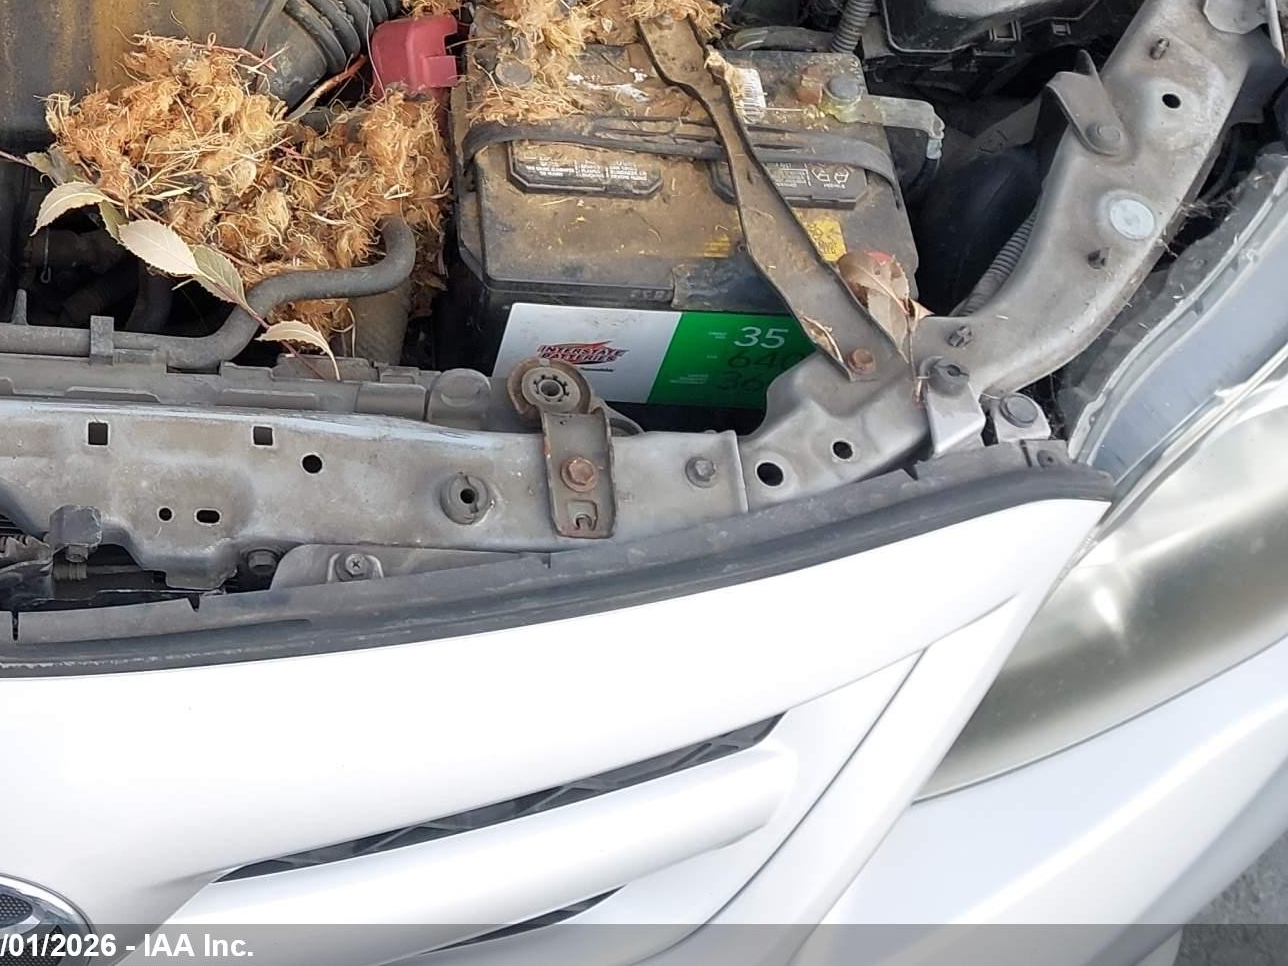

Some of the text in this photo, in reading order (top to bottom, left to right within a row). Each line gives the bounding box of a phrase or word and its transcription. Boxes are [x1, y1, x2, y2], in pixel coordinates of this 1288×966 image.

[733, 325, 789, 349] 35
[537, 344, 628, 358] INTERSTATE
[540, 352, 619, 363] BATTERIES
